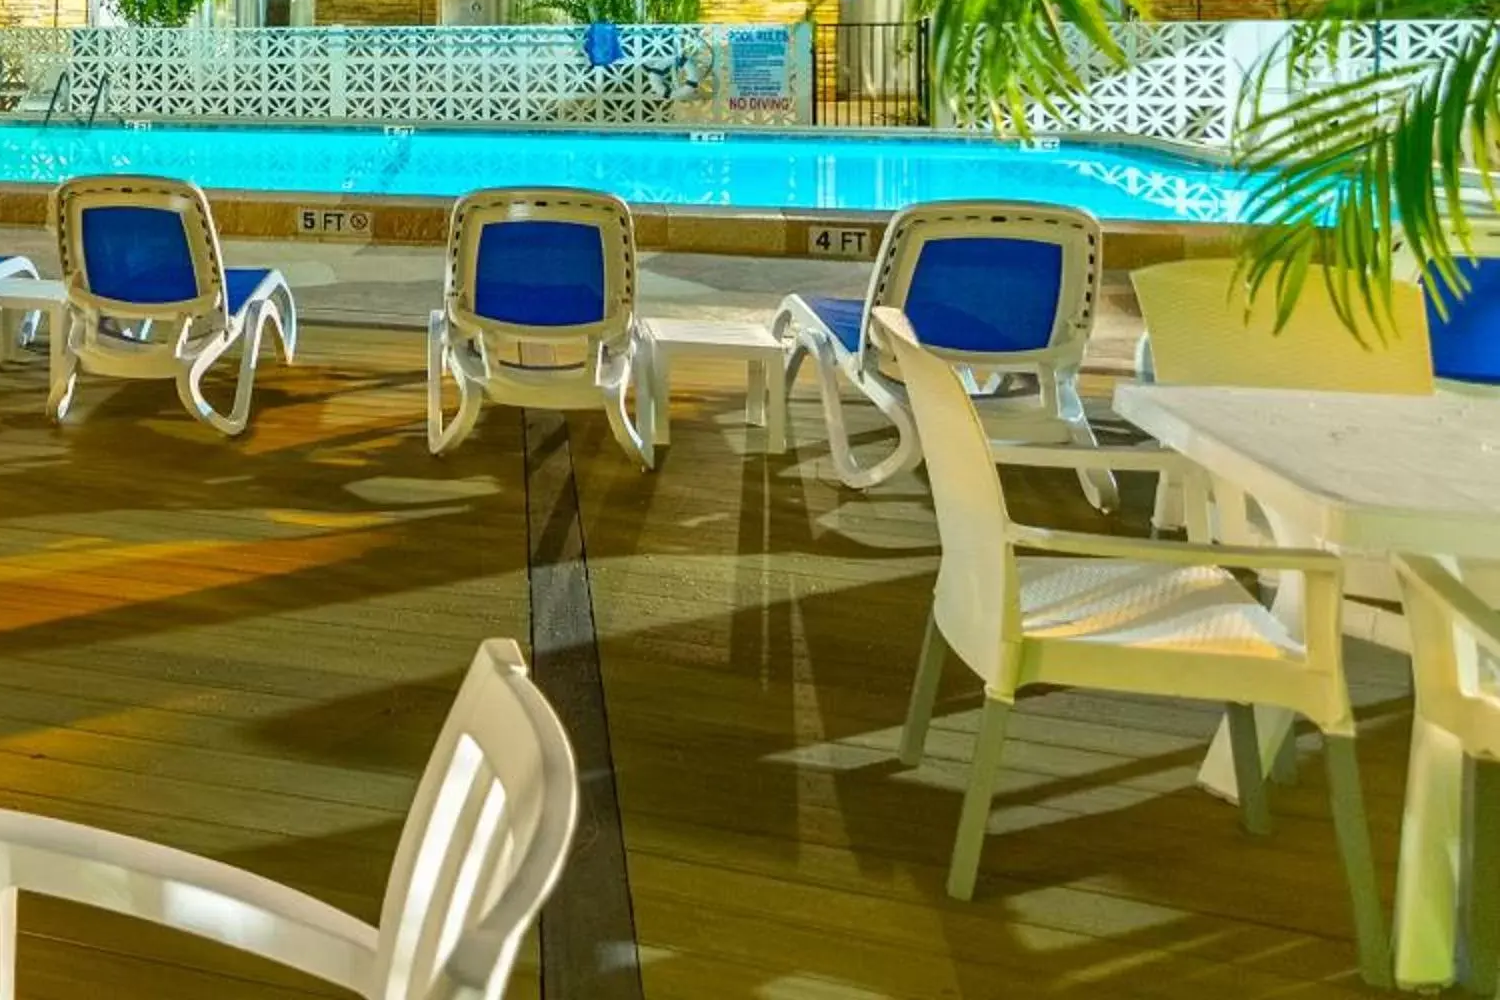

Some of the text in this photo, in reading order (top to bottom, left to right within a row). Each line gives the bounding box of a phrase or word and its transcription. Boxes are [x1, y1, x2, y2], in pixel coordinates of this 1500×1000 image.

[729, 97, 746, 110] NO
[304, 212, 344, 232] 5 FT
[816, 231, 867, 253] 4 FT
